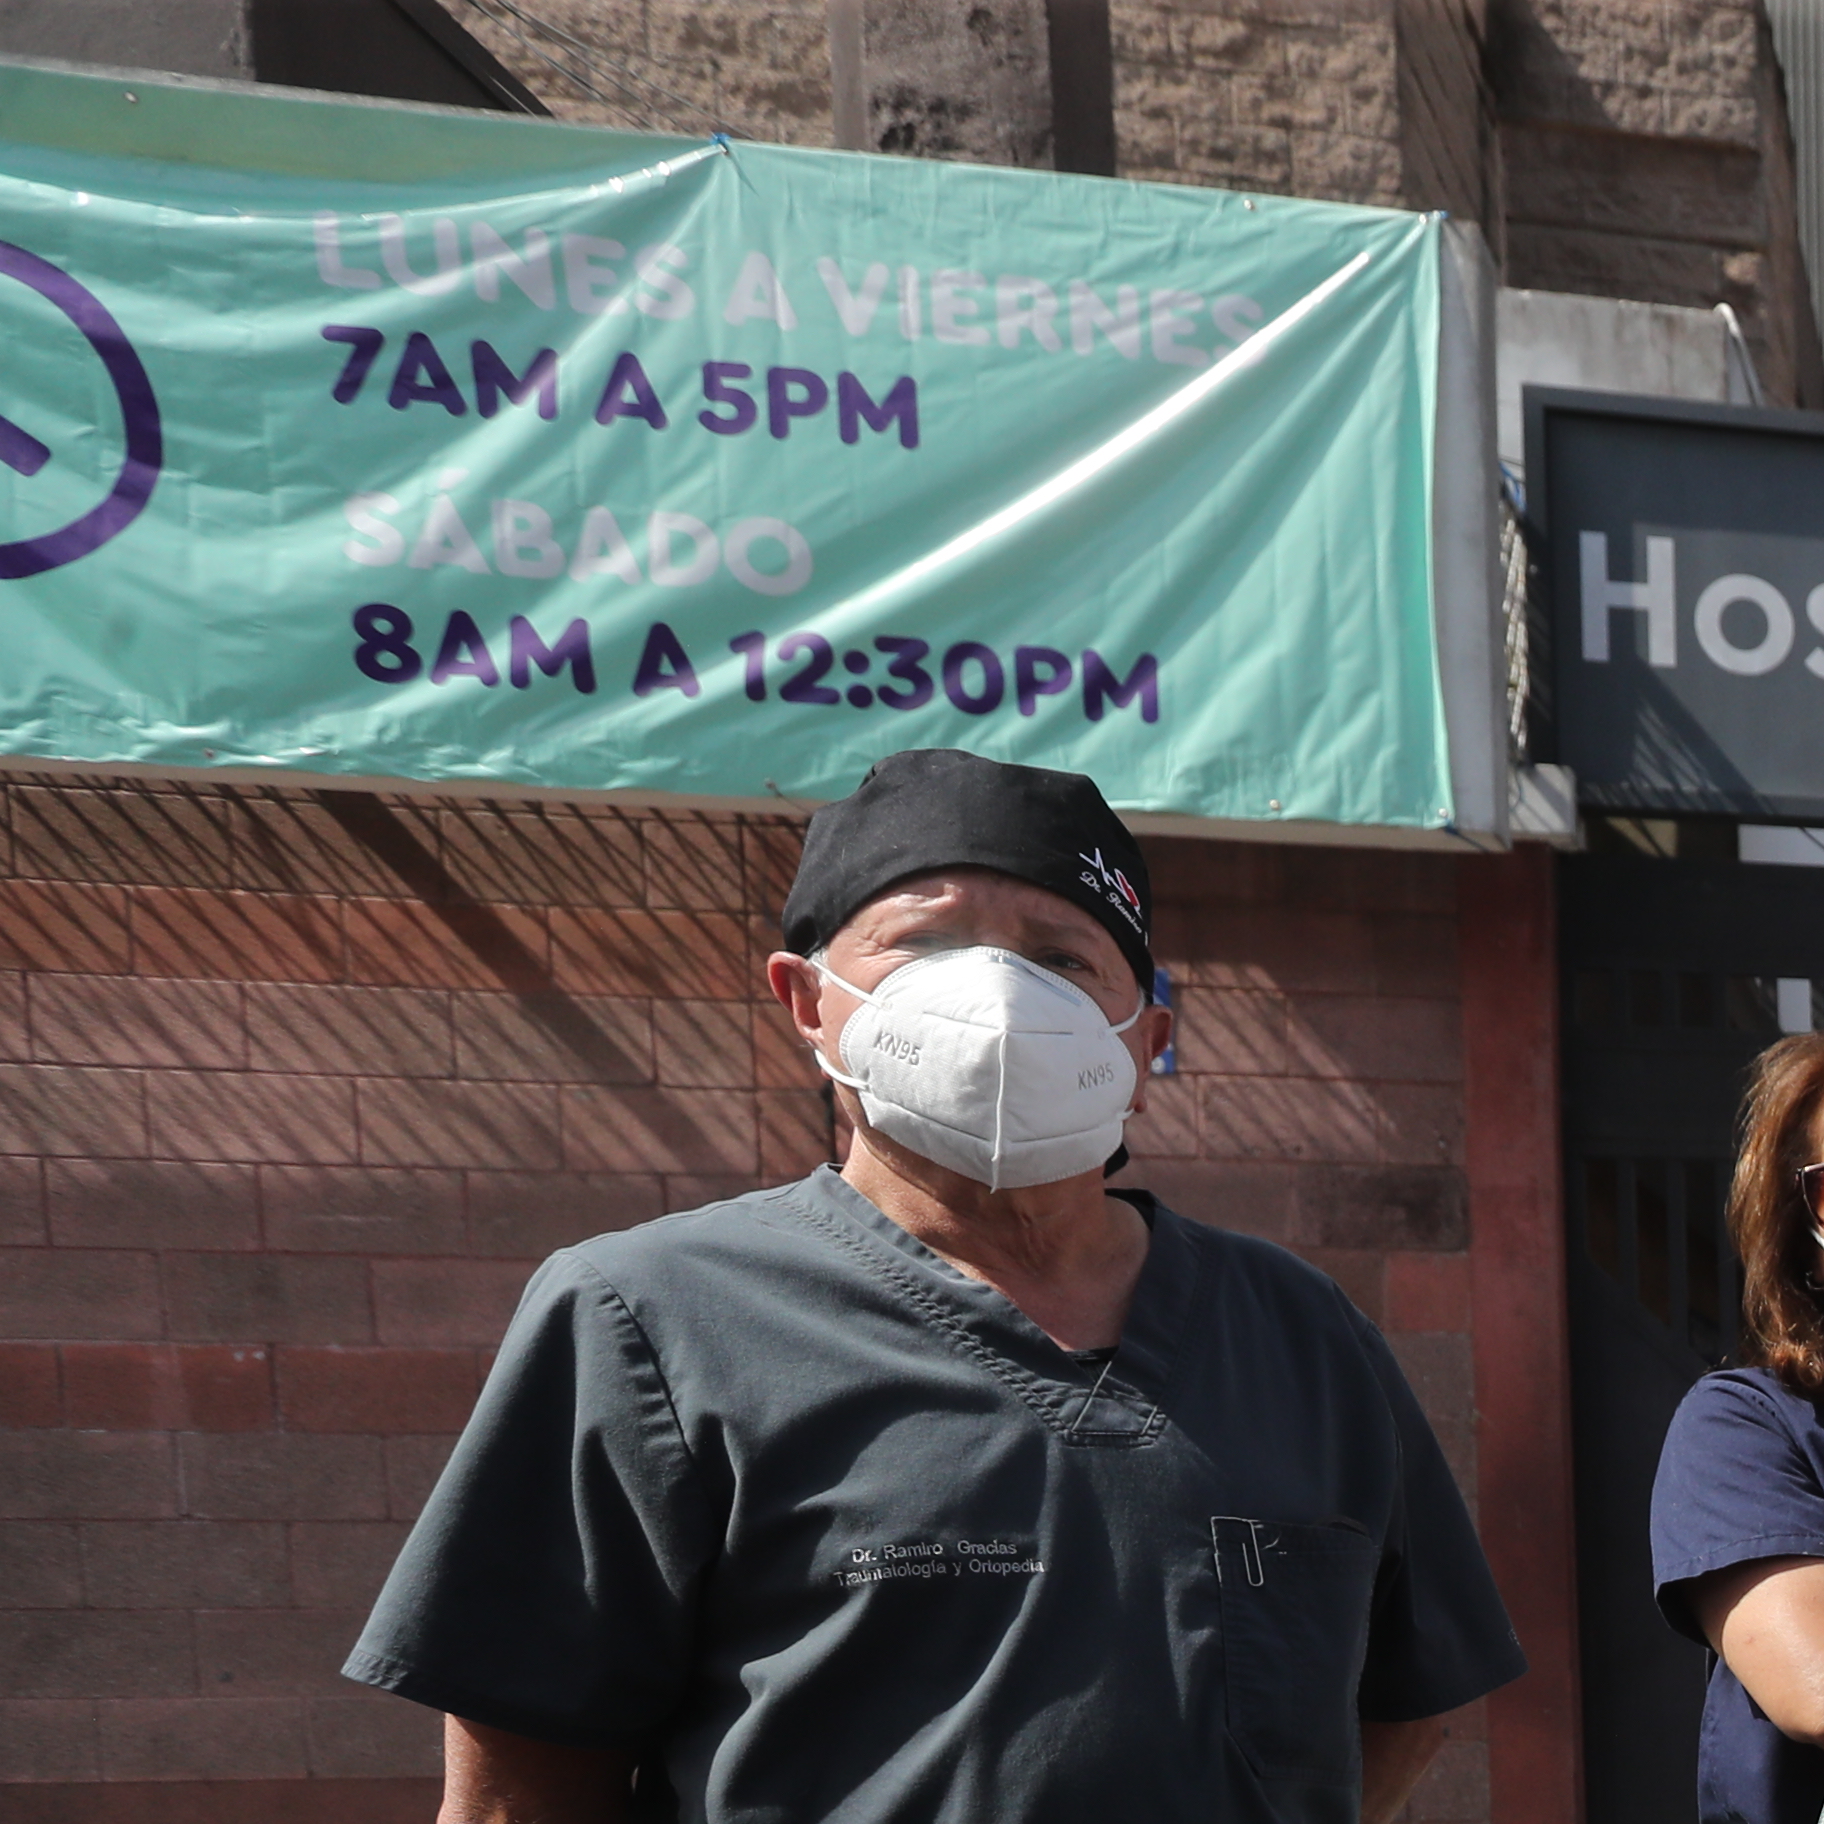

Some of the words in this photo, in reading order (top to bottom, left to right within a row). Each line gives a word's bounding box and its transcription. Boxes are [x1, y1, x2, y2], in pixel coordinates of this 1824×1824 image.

[313, 209, 696, 322] LUNES
[723, 250, 798, 331] A
[816, 255, 1268, 368] VIERNES
[321, 325, 558, 420] 7AM
[595, 352, 668, 431] A
[697, 361, 919, 450] 5PM
[341, 467, 814, 597] SÁBADO
[352, 603, 597, 695] 8AM
[632, 621, 701, 698] A
[729, 630, 1160, 723] 12:30PM
[872, 1029, 922, 1067] KN95
[1077, 1063, 1115, 1091] KN95
[851, 1547, 878, 1563] Dr.
[883, 1541, 944, 1560] Ramiro
[952, 1561, 963, 1578] y
[967, 1557, 1046, 1576] Ortopedia
